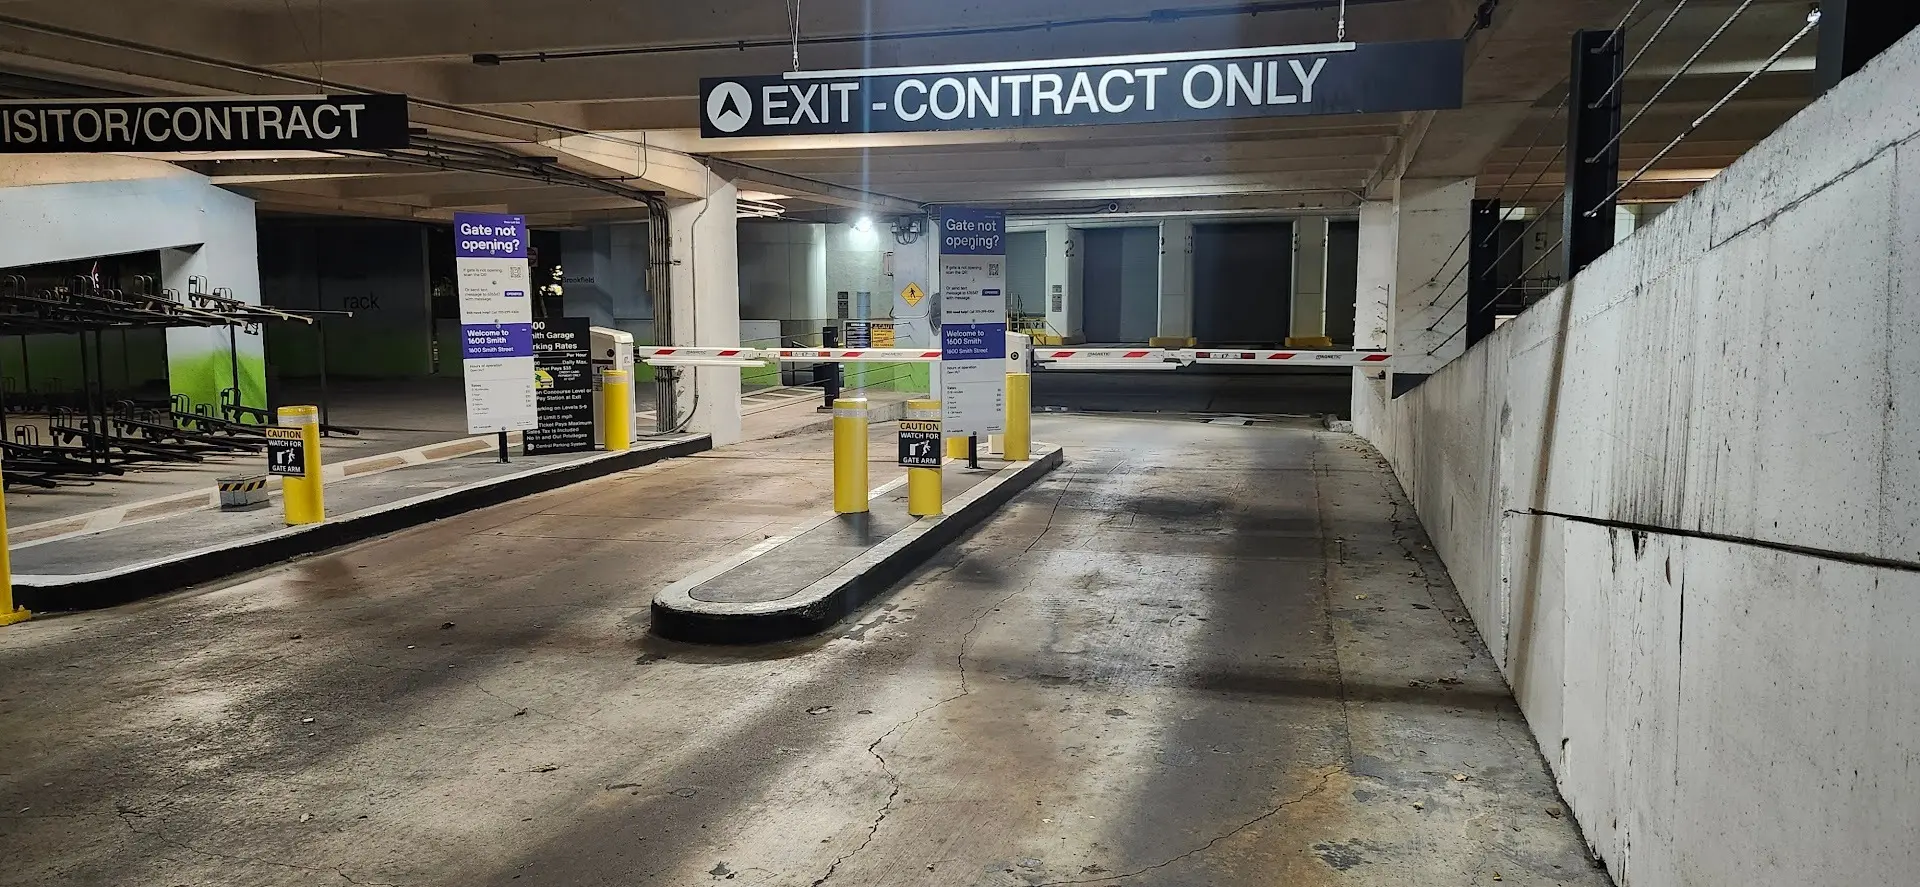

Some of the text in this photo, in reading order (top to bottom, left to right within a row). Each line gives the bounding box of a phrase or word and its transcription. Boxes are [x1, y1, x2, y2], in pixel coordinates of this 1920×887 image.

[763, 83, 859, 126] EXIT
[894, 67, 1168, 122] CONTRACT
[1182, 58, 1327, 109] ONLY
[3, 104, 365, 145] ISITOR/CONTRACT
[946, 218, 997, 231] Gate not
[460, 223, 517, 237] Gate not
[461, 238, 520, 254] opening?
[945, 234, 1000, 249] opening?
[343, 291, 380, 309] rack
[532, 322, 546, 330] 00
[467, 329, 500, 337] Welcome
[546, 332, 575, 340] Garage
[946, 330, 977, 338] Welcome
[467, 337, 486, 345] 1600
[963, 337, 982, 345] Smith
[532, 342, 578, 351] rking Rates
[900, 422, 939, 431] CAUTION
[267, 429, 301, 439] CAUTION
[900, 431, 940, 440] WATCH FOR
[289, 440, 302, 448] FOR
[920, 457, 937, 465] ARM
